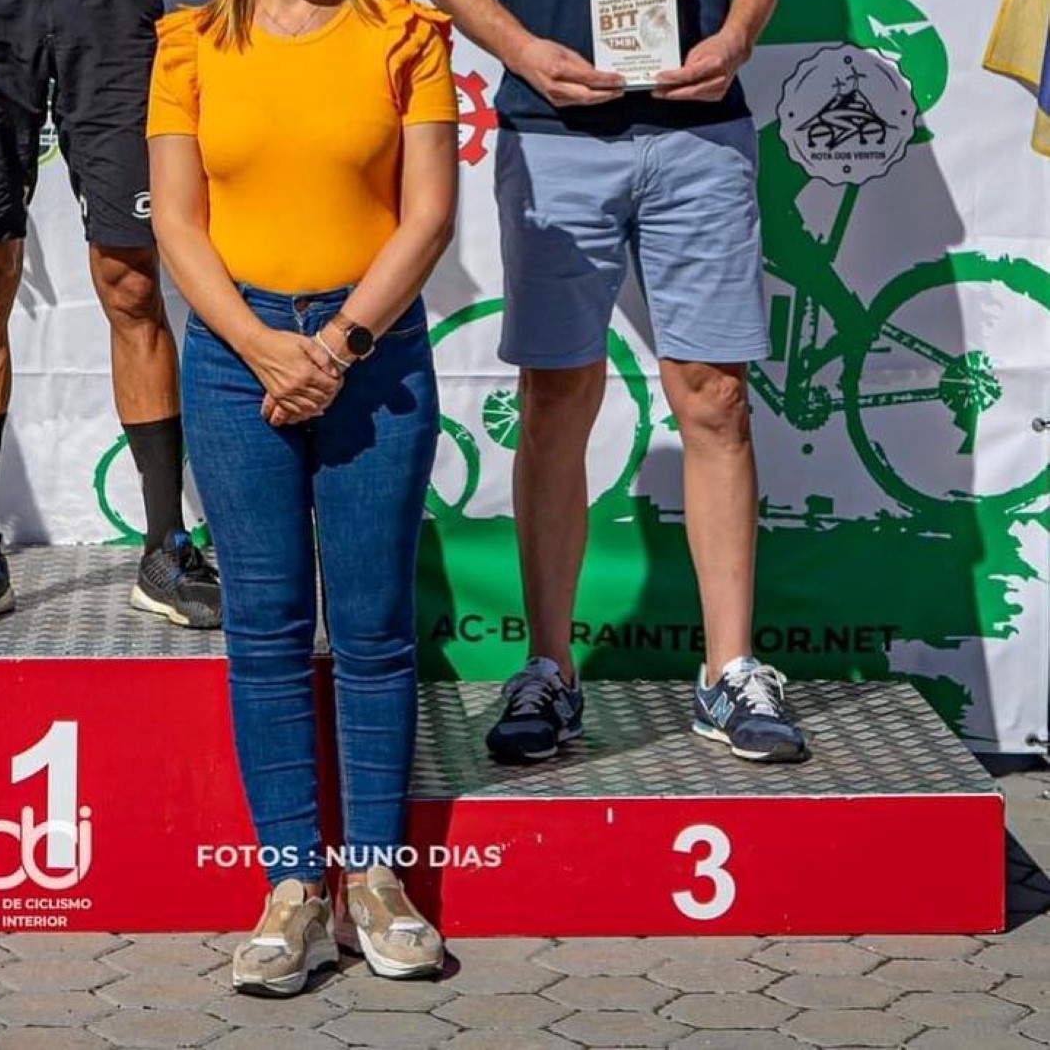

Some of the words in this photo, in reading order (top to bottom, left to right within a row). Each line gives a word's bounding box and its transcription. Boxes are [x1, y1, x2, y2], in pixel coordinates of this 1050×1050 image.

[599, 10, 638, 31] BTT
[810, 152, 832, 161] ROTA
[834, 152, 852, 160] DOS
[854, 151, 886, 160] VENTOS
[11, 721, 78, 867] 1
[672, 824, 736, 920] 3
